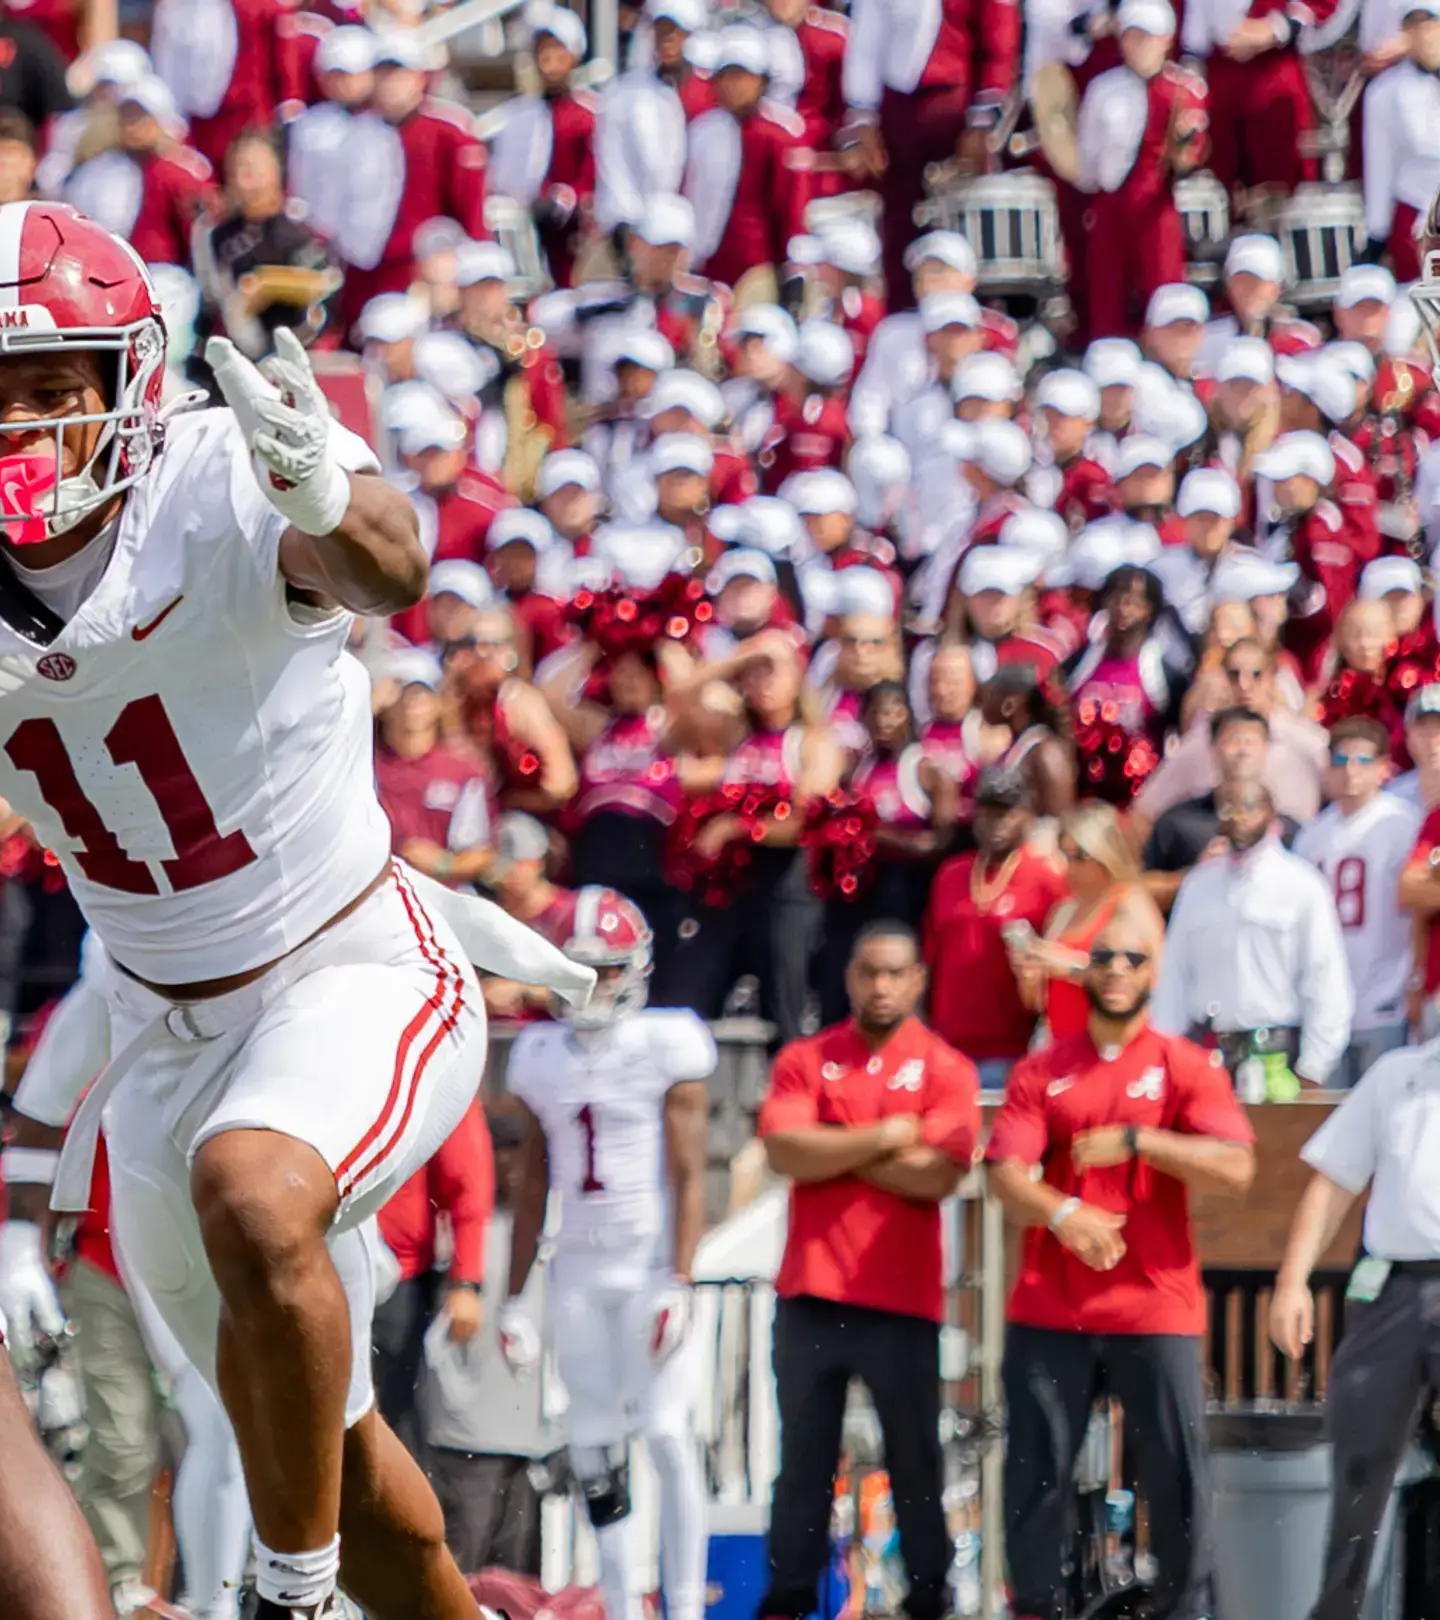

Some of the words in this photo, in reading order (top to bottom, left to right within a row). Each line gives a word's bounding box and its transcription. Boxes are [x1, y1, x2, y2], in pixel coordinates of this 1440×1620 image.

[38, 654, 75, 680] SEC
[3, 693, 258, 896] 11
[575, 1103, 605, 1193] 1
